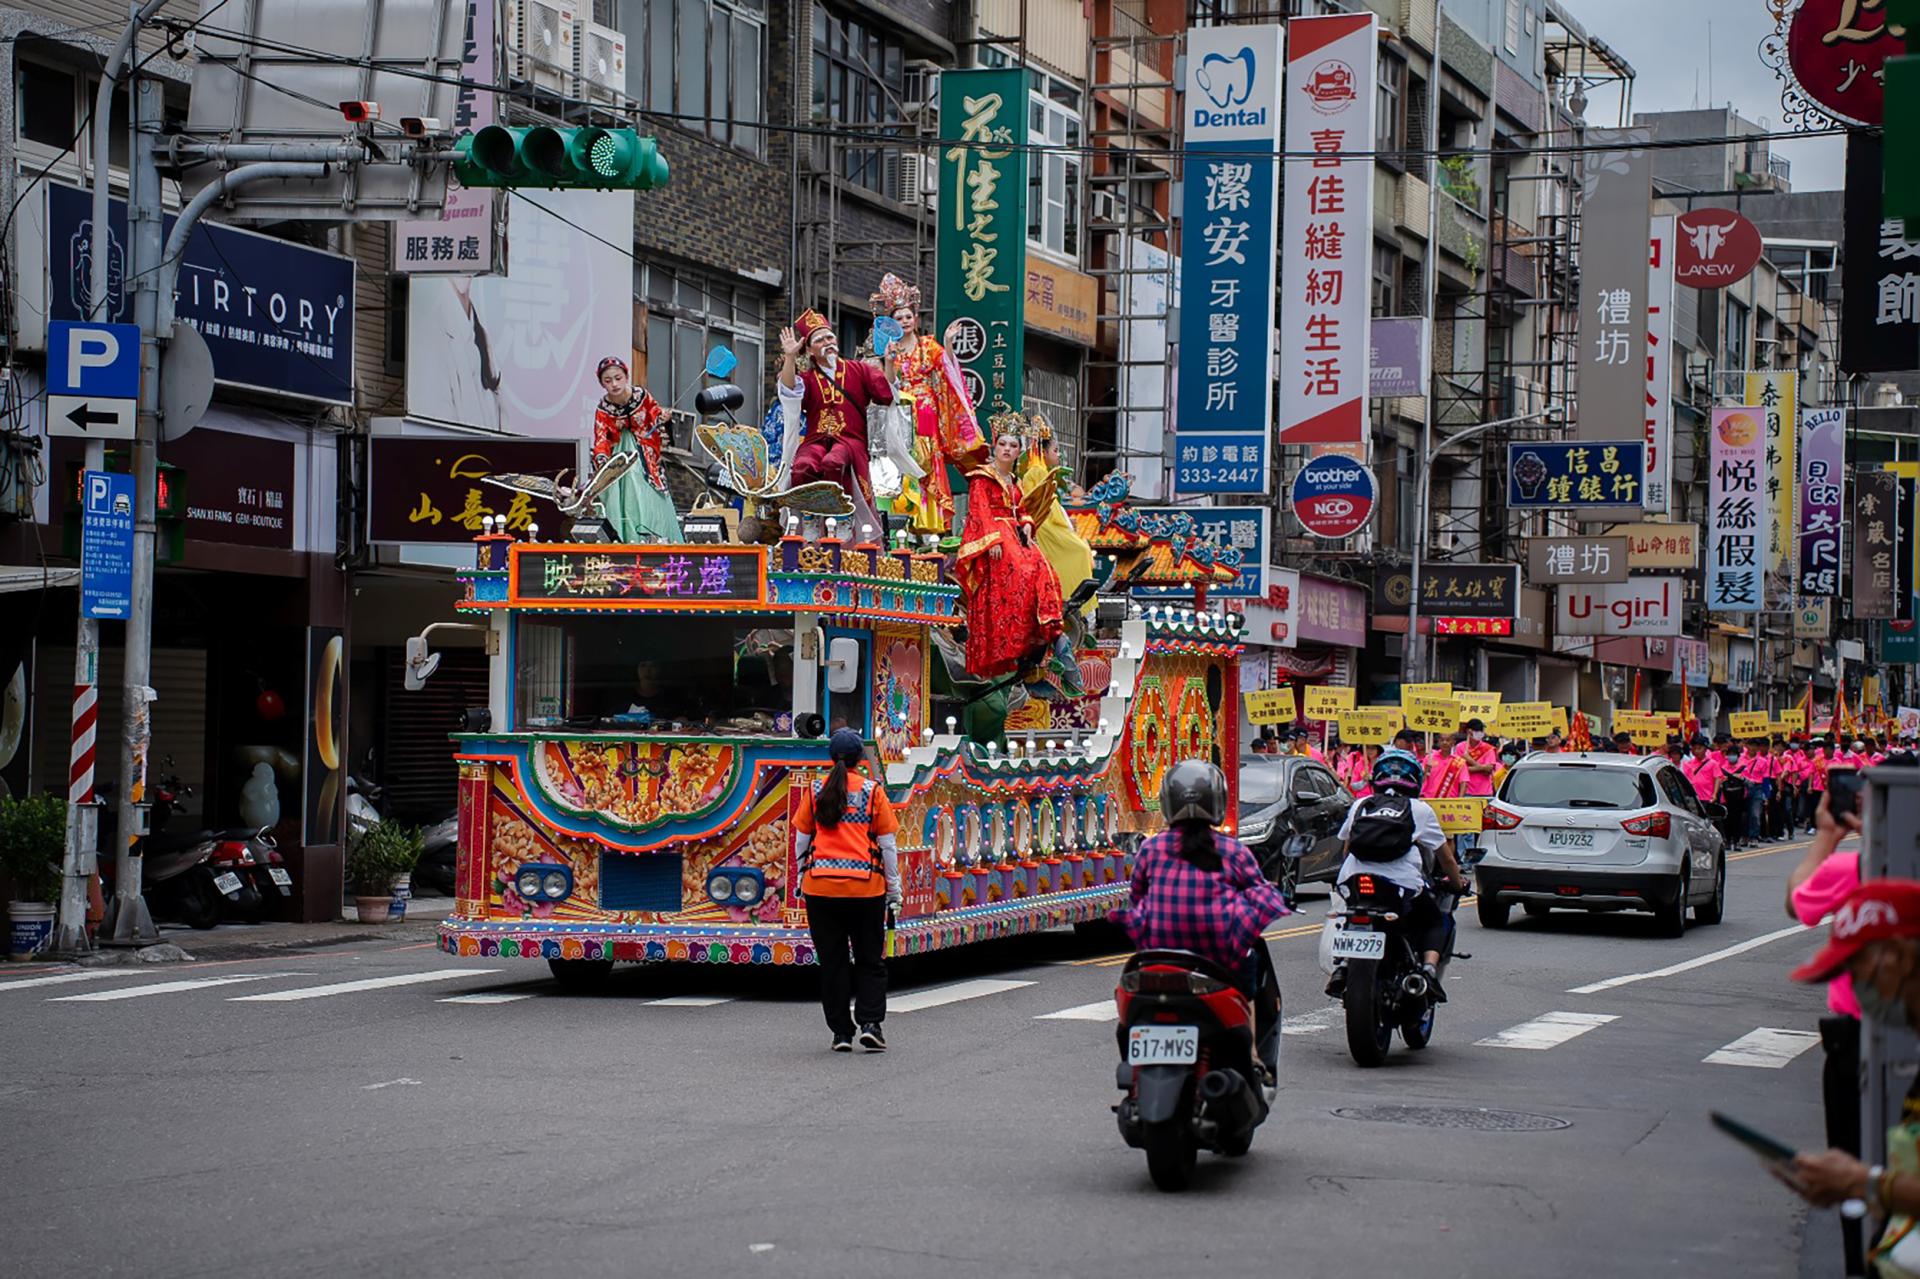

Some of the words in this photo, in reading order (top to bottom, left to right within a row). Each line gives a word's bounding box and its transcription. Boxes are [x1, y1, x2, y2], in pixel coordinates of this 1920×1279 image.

[1194, 107, 1266, 127] Dental
[946, 93, 1013, 301] 花生之家
[405, 235, 480, 261] 服務處
[1303, 128, 1345, 396] 喜佳縫紉生活
[1203, 162, 1252, 412] 潔安牙醫診所
[1594, 288, 1631, 366] 禮坊
[67, 328, 119, 388] P
[1804, 410, 1841, 431] BELLO
[1182, 445, 1259, 463] 約診電話
[1566, 446, 1620, 475] 信昌
[1181, 468, 1259, 484] 333-2447
[1305, 468, 1361, 484] brother
[1546, 473, 1638, 502] 鐘錶行
[91, 479, 107, 510] P
[409, 488, 537, 531] 山喜房
[215, 511, 232, 522] FANG
[1715, 459, 1757, 604] 悅絲假髮
[1803, 461, 1840, 594] 貝歐大尺碼
[1202, 519, 1257, 549] 牙醫
[1545, 544, 1610, 576] 禮坊
[1569, 582, 1668, 629] U-girl
[1333, 937, 1383, 953] NWM-2979
[1131, 1039, 1195, 1058] 617-MVS
